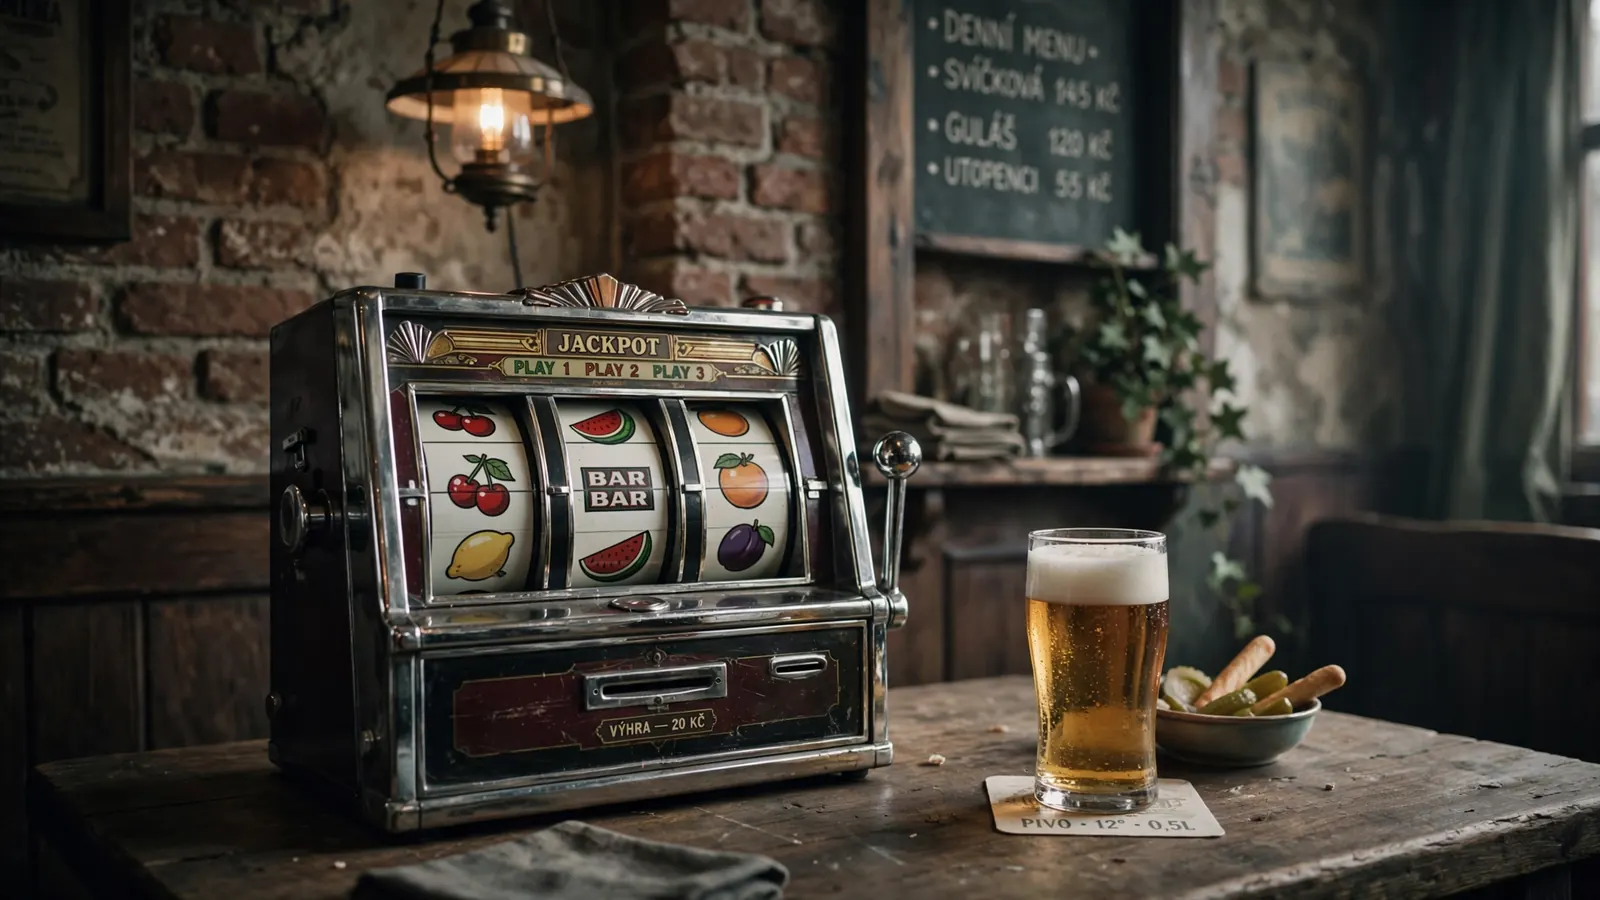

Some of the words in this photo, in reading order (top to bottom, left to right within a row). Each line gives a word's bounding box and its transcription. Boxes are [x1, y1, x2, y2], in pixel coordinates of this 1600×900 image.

[944, 8, 1017, 51] DENNÍ
[1022, 25, 1087, 65] MENU
[943, 55, 1045, 102] SVÍČKOVÁ
[1055, 77, 1092, 109] 145
[944, 110, 1018, 151] GULÁŠ
[1049, 127, 1085, 158] 120
[944, 156, 1039, 194] UTOPENCI
[1055, 168, 1083, 199] 55
[557, 334, 660, 356] JACKPOT
[513, 360, 556, 375] PLAY
[562, 361, 571, 376] 1
[585, 363, 625, 377] PLAY
[629, 364, 640, 378] 2
[652, 364, 691, 379] PLAY
[696, 366, 705, 380] 3
[588, 471, 647, 486] BAR
[590, 491, 649, 507] BAR
[609, 721, 651, 738] VÝHRA
[671, 717, 687, 732] 20
[690, 711, 706, 730] KČ
[1021, 818, 1072, 829] PIVO
[1095, 819, 1126, 830] 12°
[1148, 819, 1197, 832] 0,5L
